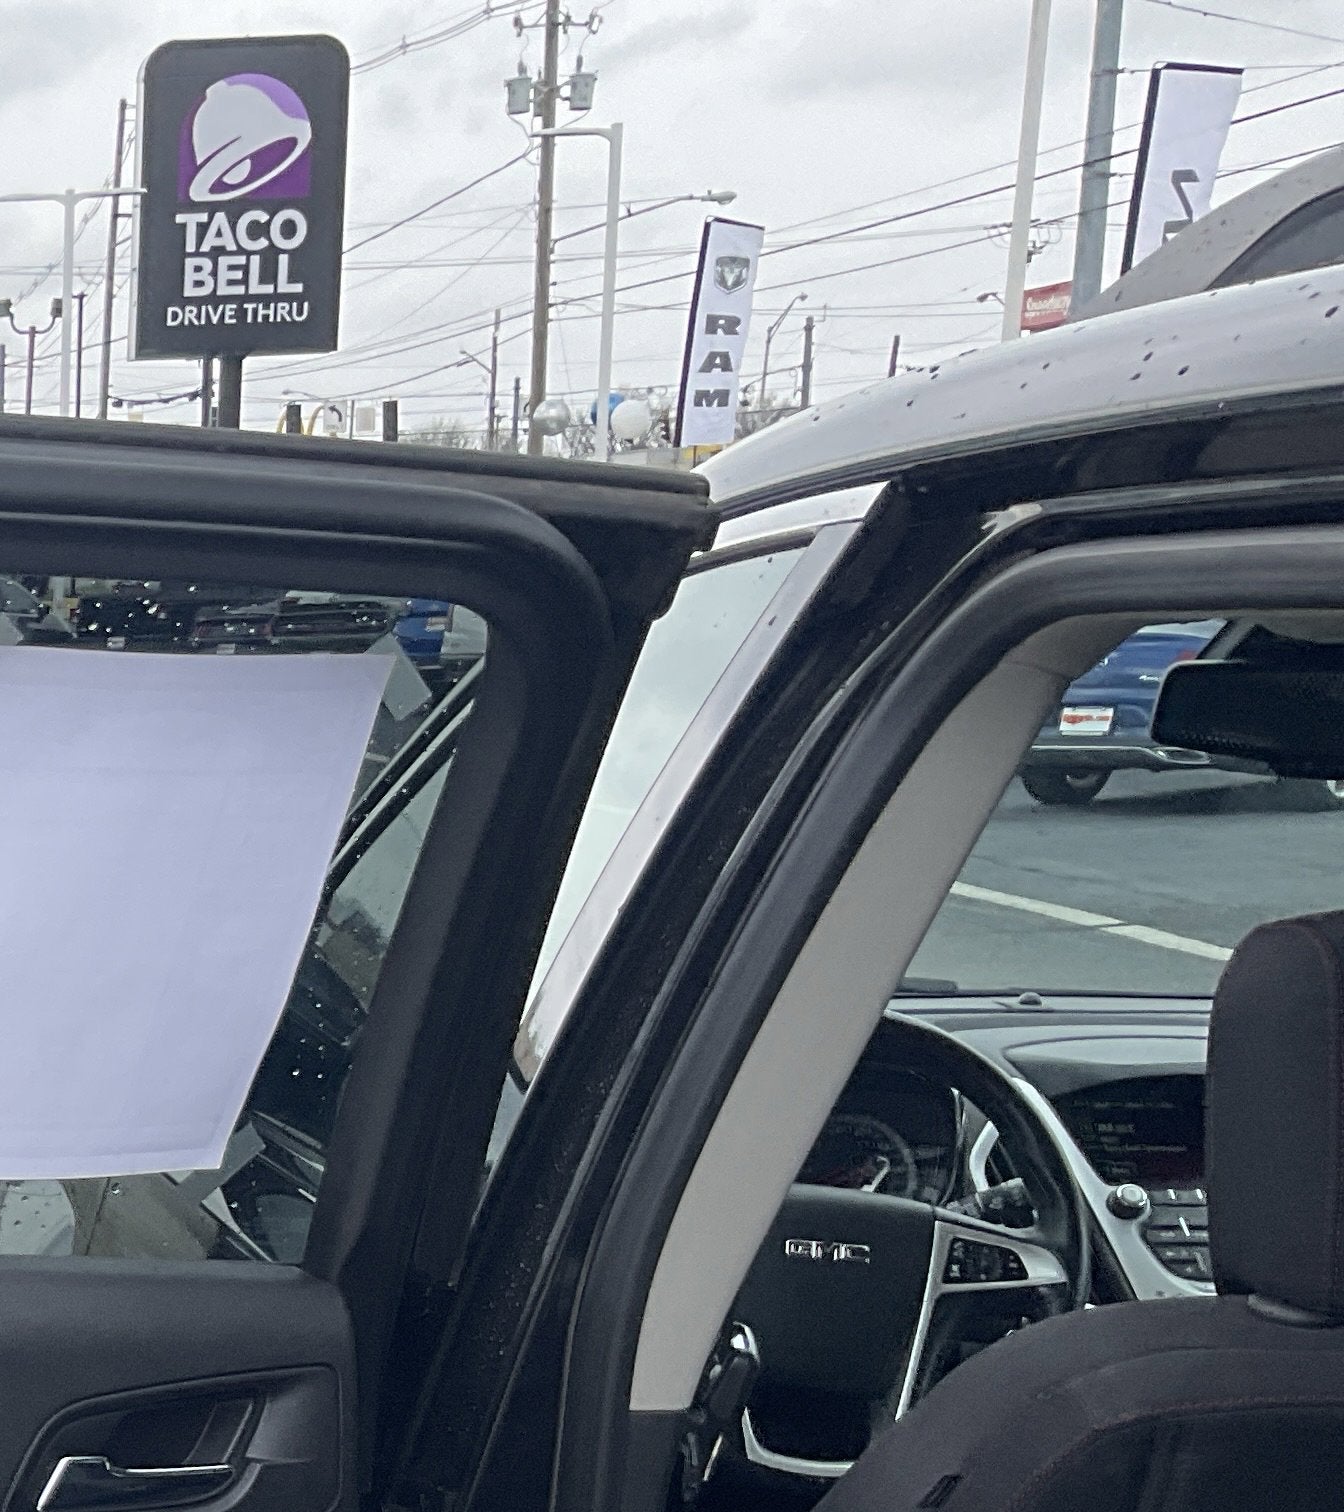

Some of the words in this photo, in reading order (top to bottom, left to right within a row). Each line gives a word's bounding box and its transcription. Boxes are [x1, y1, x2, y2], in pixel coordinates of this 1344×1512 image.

[175, 209, 308, 253] TACO
[183, 253, 304, 298] BELL
[166, 304, 237, 326] DRIVE
[243, 301, 309, 324] THRU
[693, 313, 742, 408] RAM
[785, 1239, 870, 1264] GMC
